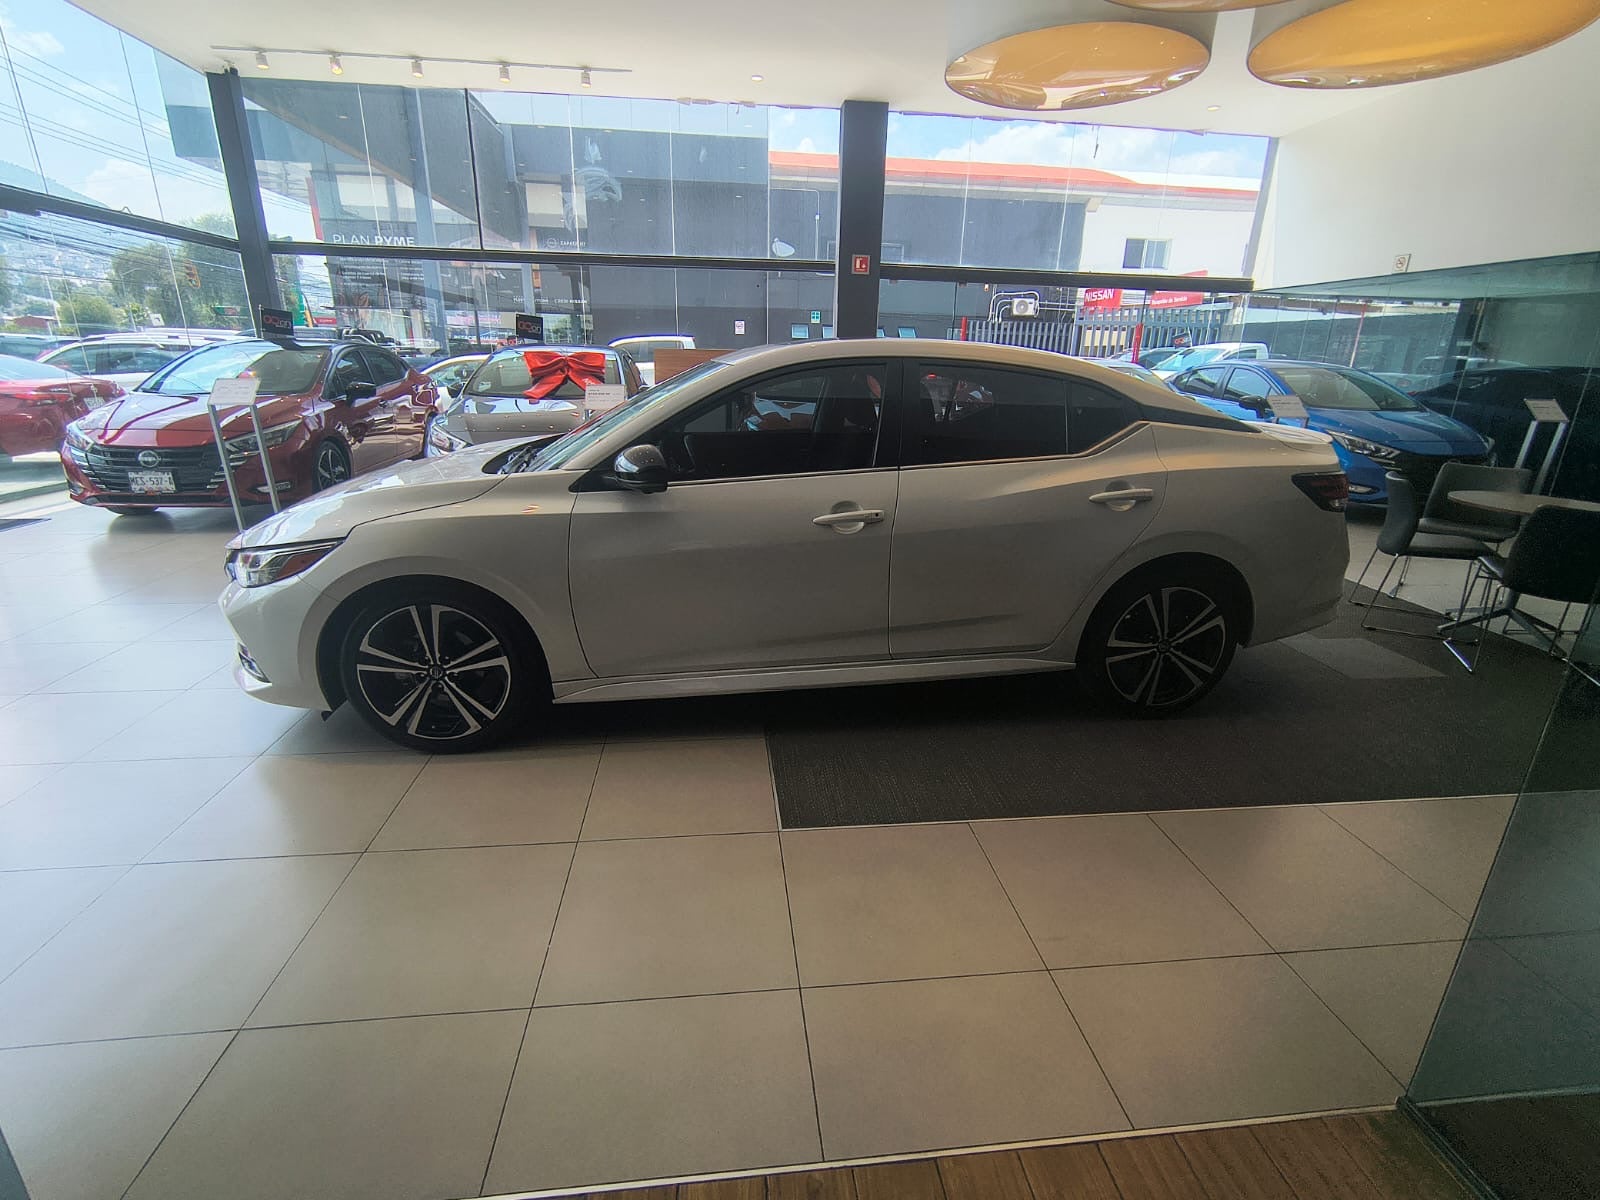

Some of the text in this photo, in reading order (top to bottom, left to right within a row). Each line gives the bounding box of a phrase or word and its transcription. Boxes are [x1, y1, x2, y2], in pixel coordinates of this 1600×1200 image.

[332, 234, 415, 247] PLAN PYME
[1085, 288, 1115, 302] NISSAN
